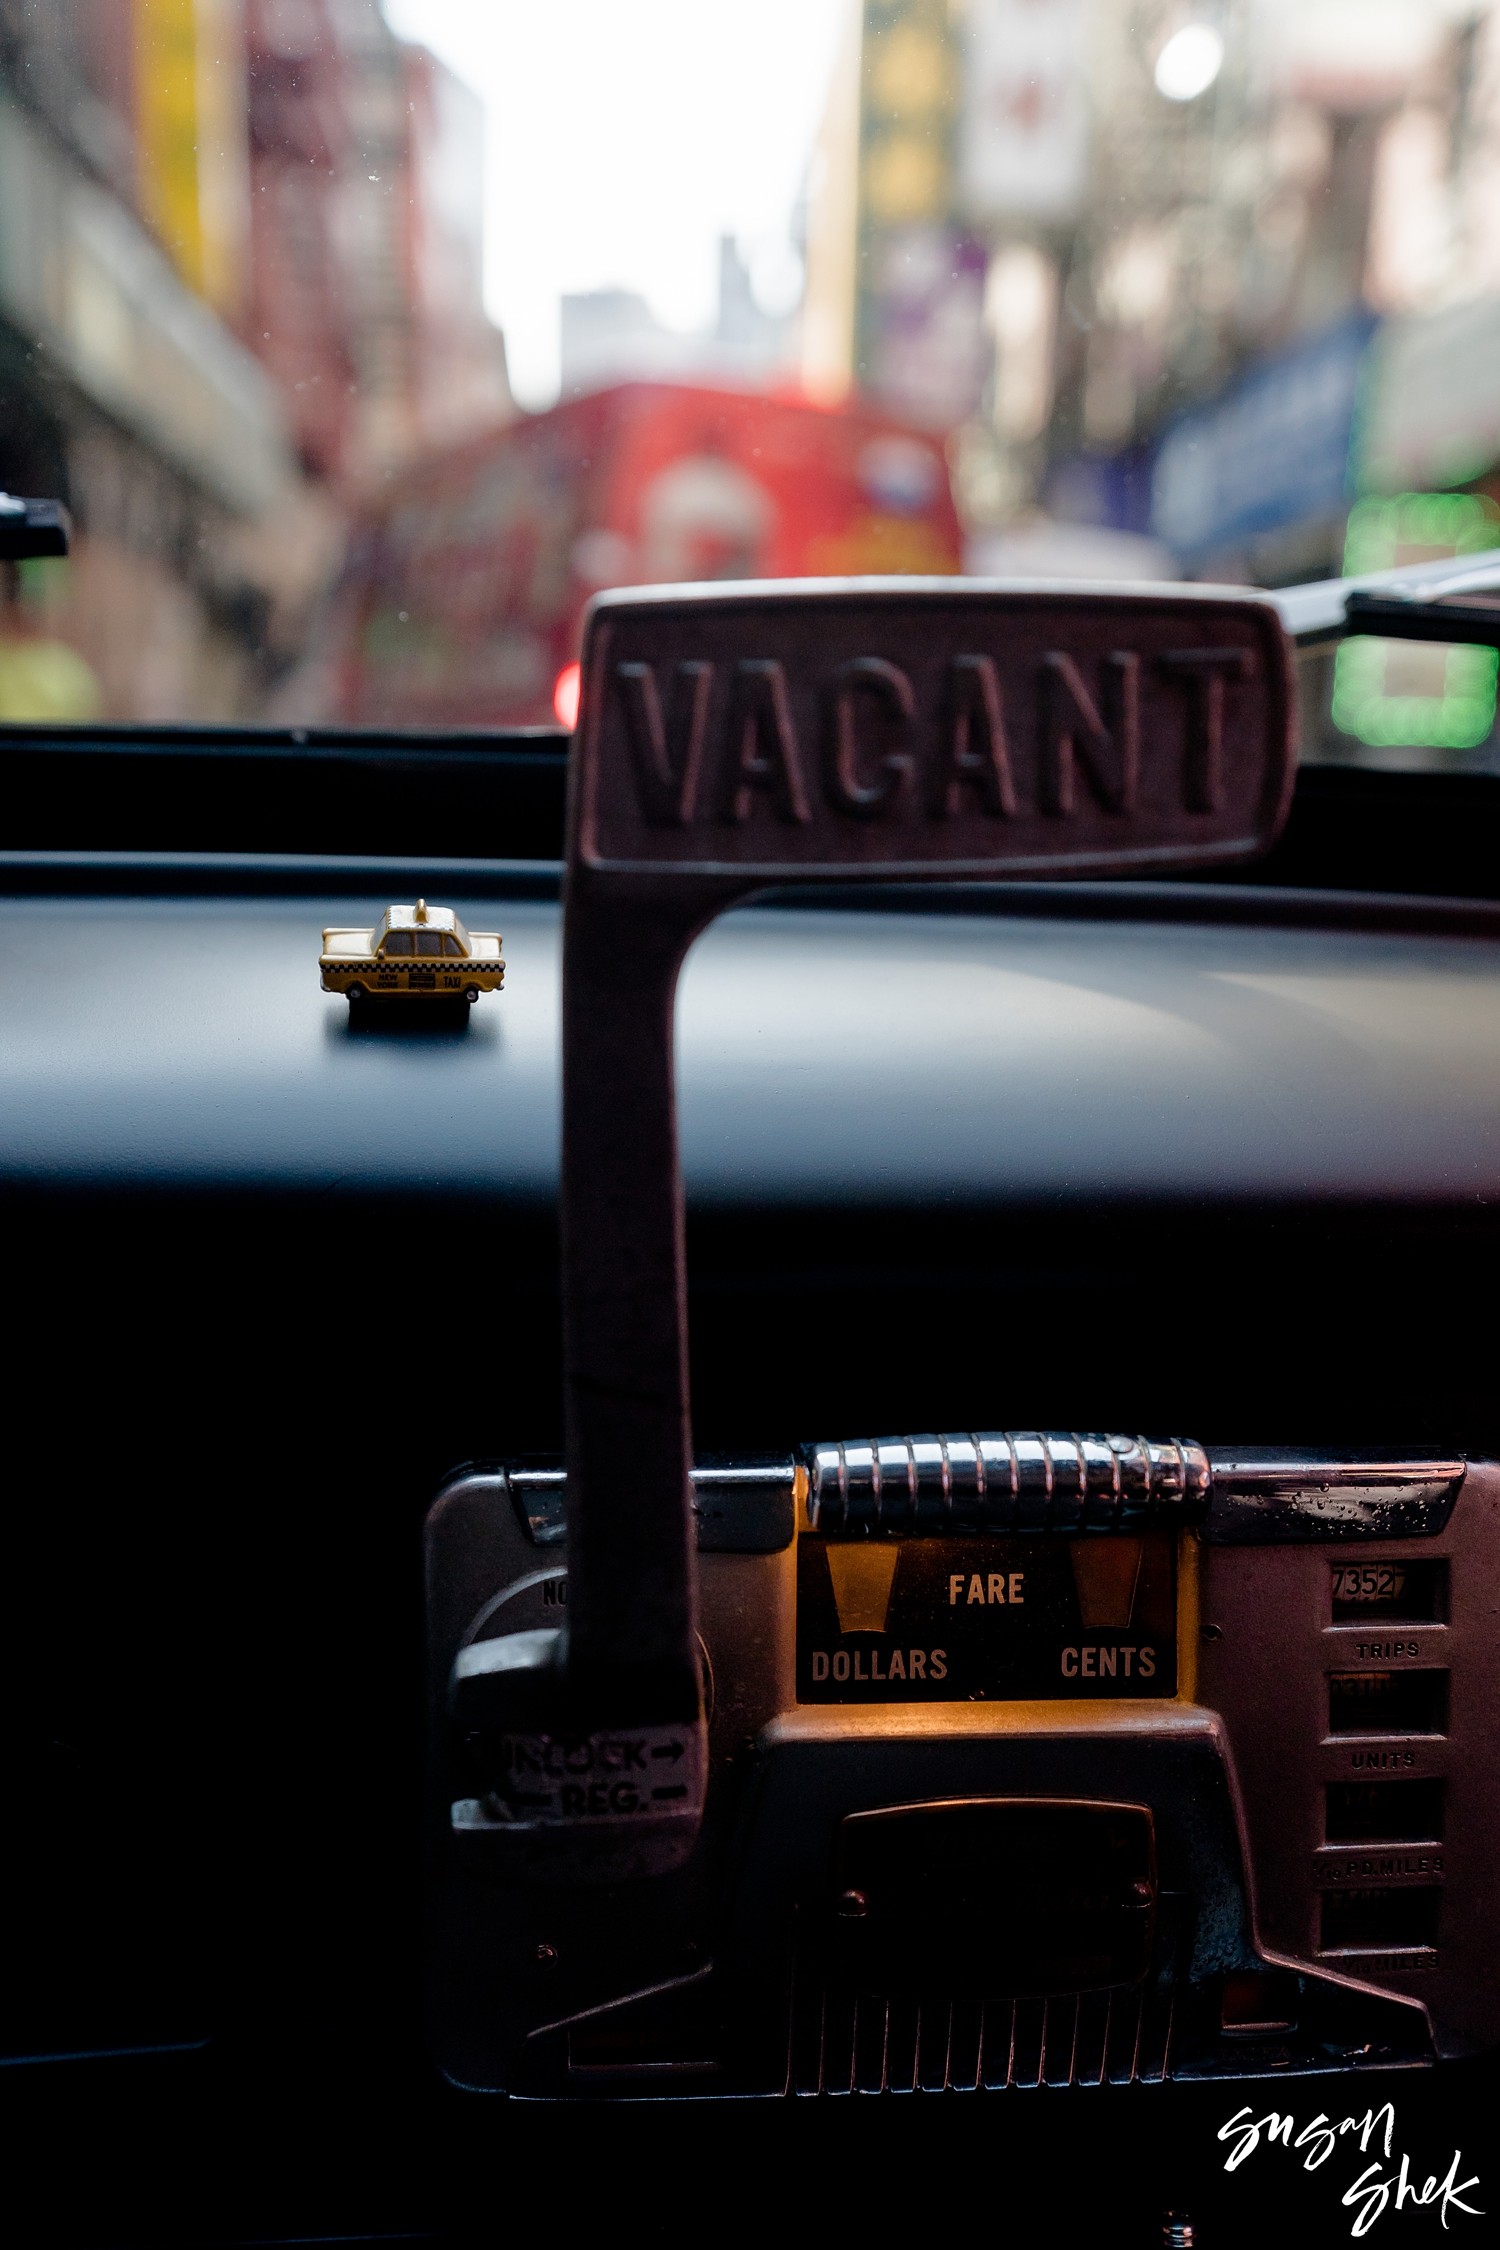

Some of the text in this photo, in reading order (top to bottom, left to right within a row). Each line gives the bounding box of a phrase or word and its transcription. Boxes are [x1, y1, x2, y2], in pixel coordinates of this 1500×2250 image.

[614, 647, 1257, 826] VACANT
[376, 981, 399, 989] YORK
[378, 973, 398, 981] NEW
[443, 976, 461, 988] TAXI
[949, 1572, 1025, 1606] FARE
[1355, 1642, 1420, 1660] TRIPS
[811, 1648, 949, 1682] DOLLARS
[1060, 1646, 1157, 1678] CENTS
[1351, 1752, 1416, 1769] UNITS
[560, 1782, 648, 1814] REG.
[1375, 1953, 1440, 1971] MILES
